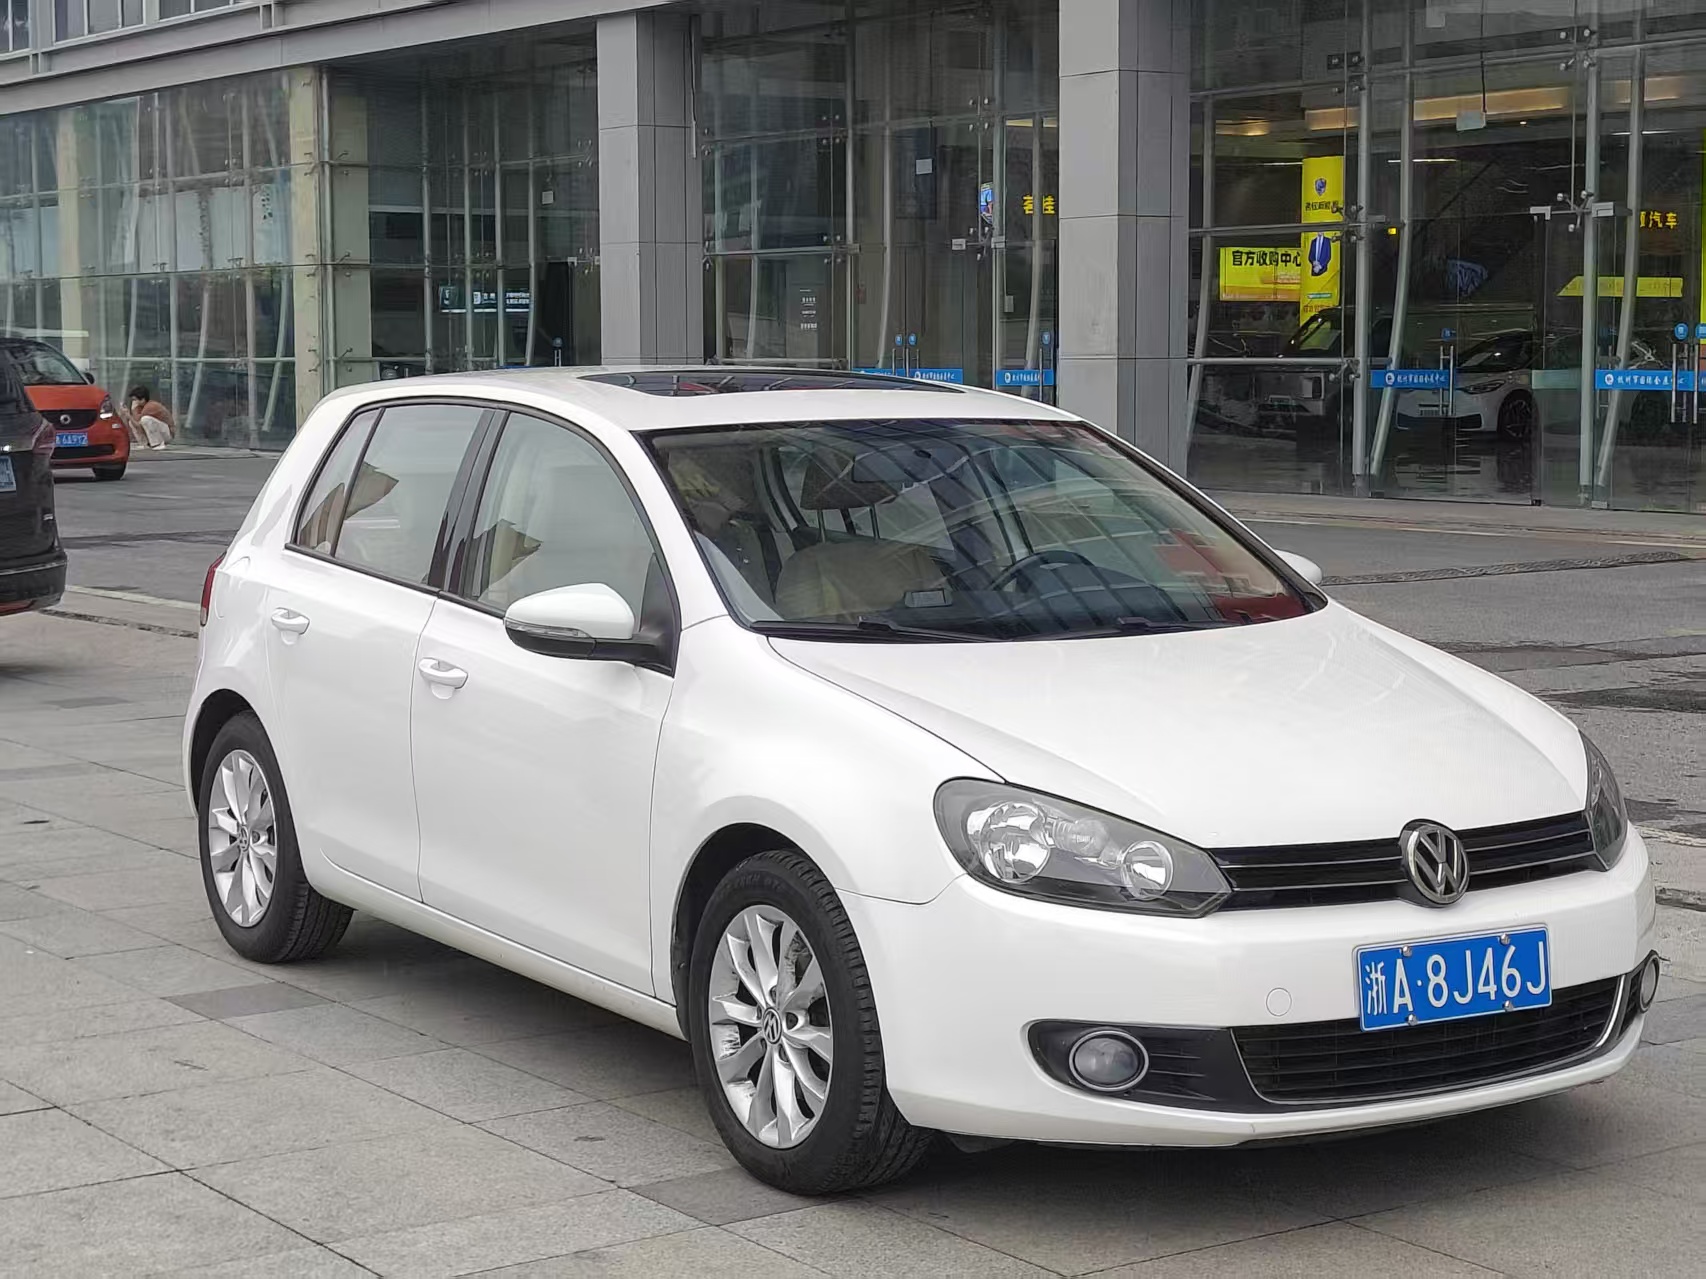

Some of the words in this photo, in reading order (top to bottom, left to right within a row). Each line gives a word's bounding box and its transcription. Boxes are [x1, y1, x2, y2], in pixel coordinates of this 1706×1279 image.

[1232, 251, 1301, 267] 官方收购中心
[1365, 941, 1547, 1015] 浙A·8J46J
